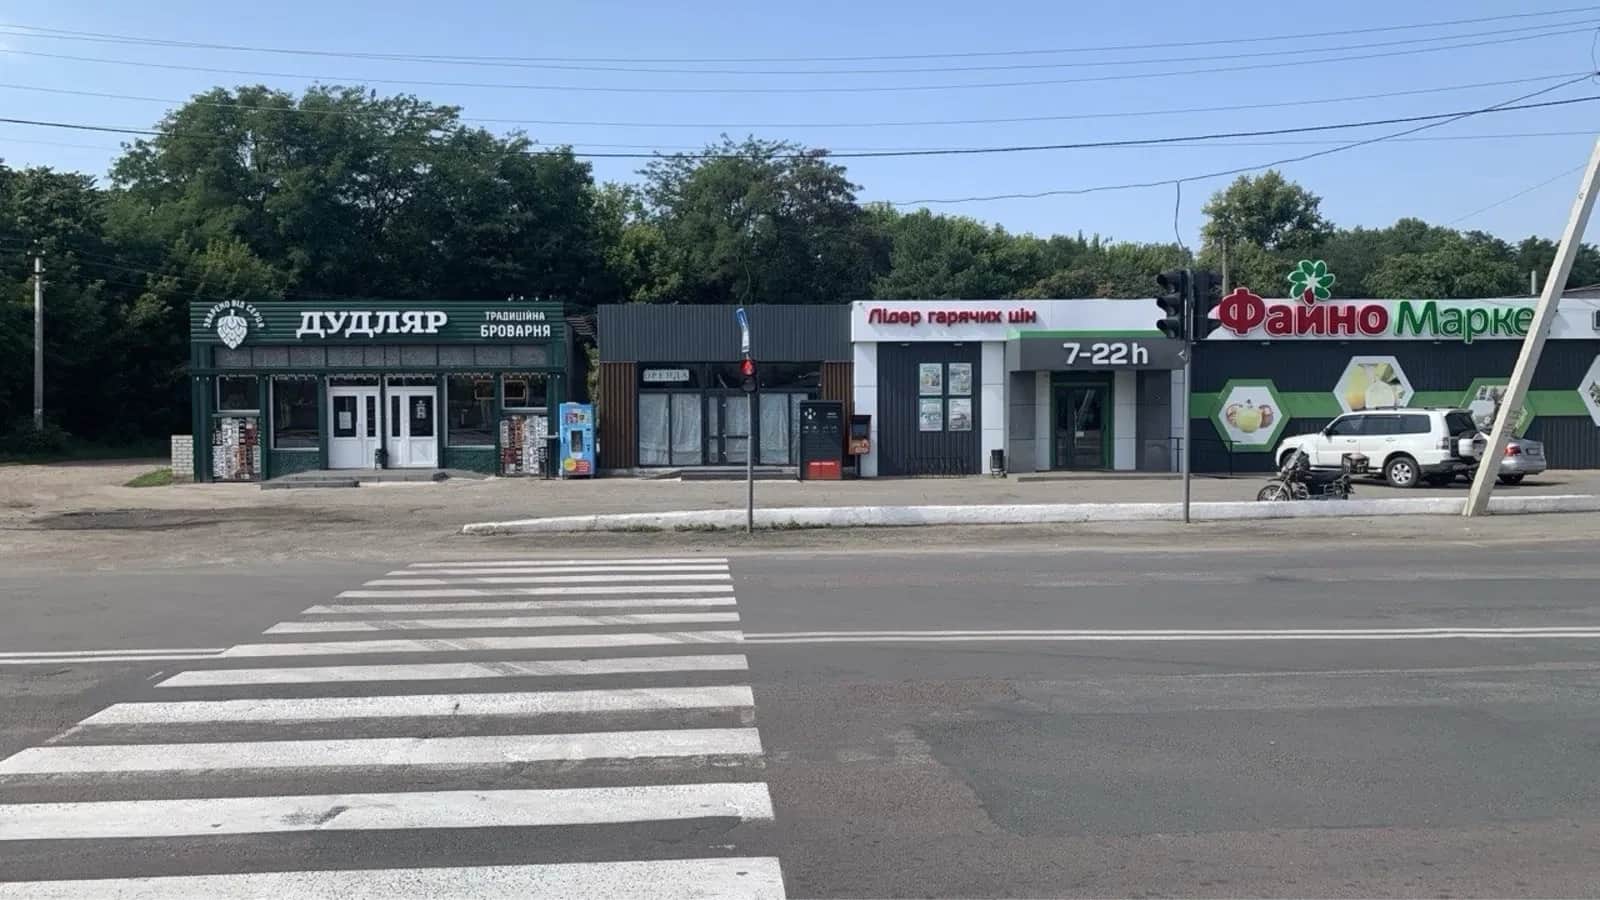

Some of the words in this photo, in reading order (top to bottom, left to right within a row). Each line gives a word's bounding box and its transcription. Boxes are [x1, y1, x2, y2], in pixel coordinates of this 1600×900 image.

[485, 310, 546, 321] ТРАДИЦІЙНА
[869, 308, 921, 327] Лідер
[928, 310, 1002, 327] гарячих
[1008, 308, 1037, 324] цін
[1218, 287, 1389, 337] Файно
[1397, 301, 1536, 343] Марке
[296, 311, 448, 339] ДУДЛЯР
[480, 324, 551, 337] БРОВАРНЯ
